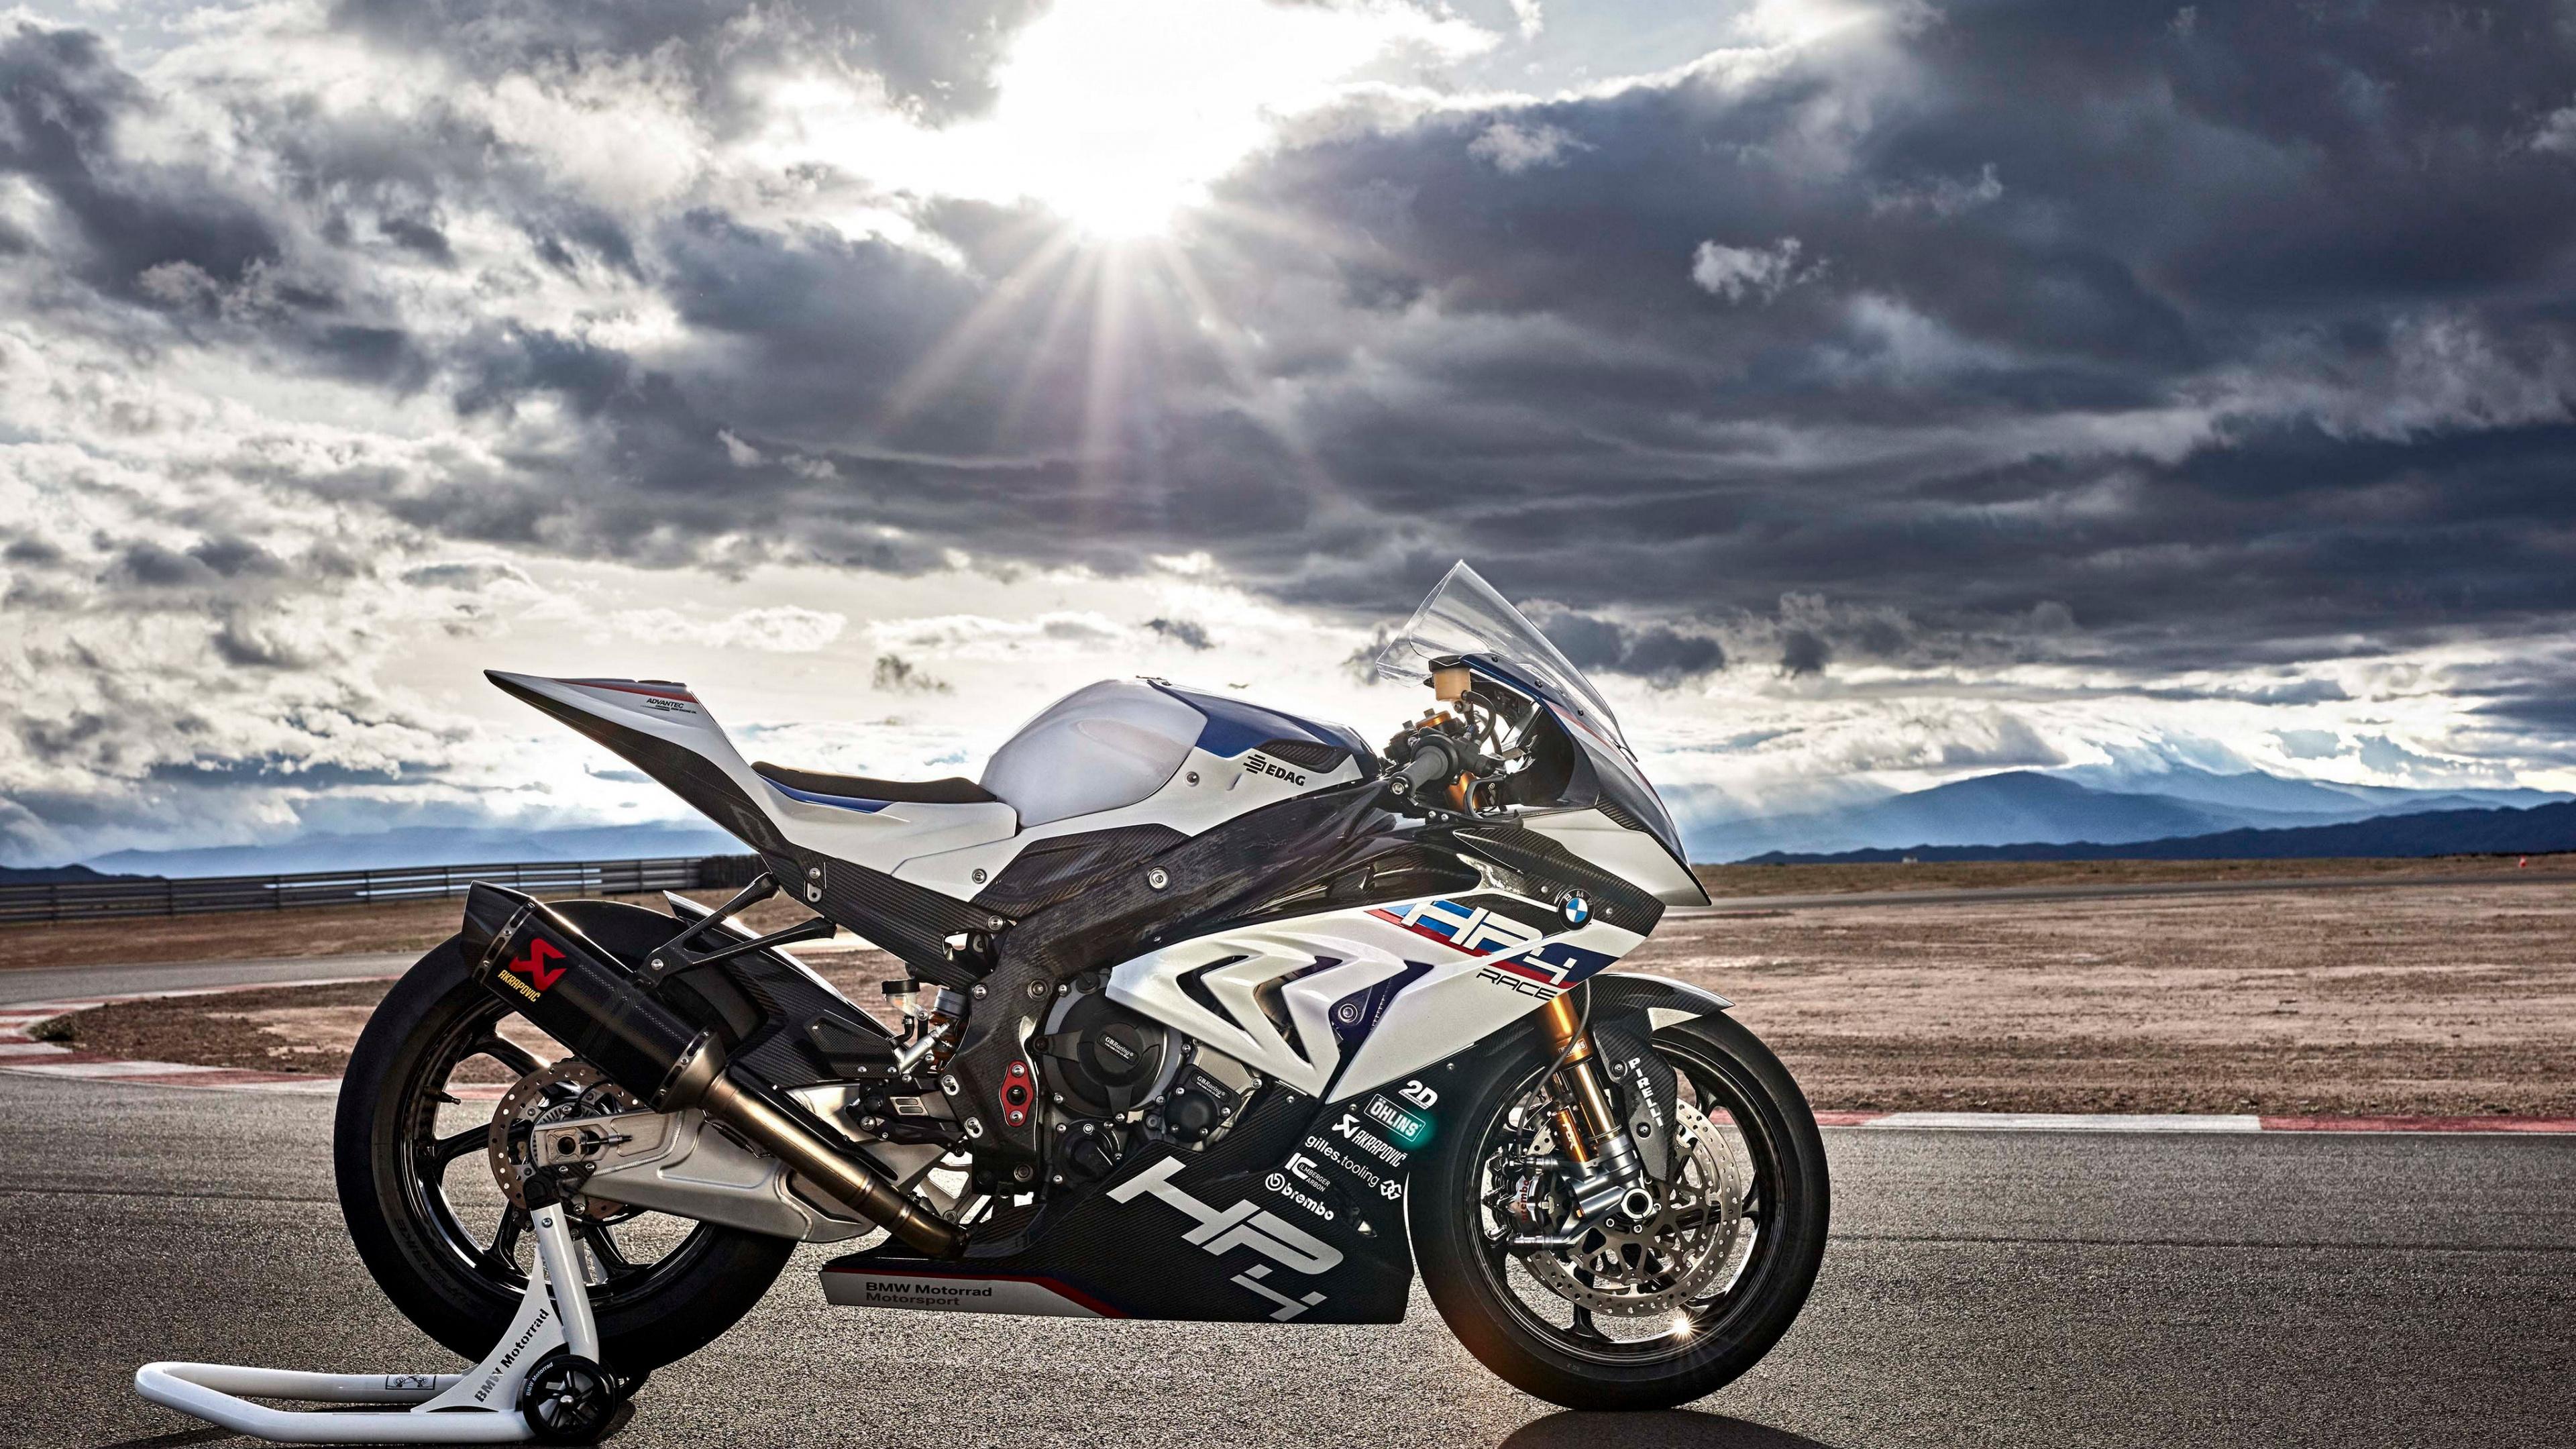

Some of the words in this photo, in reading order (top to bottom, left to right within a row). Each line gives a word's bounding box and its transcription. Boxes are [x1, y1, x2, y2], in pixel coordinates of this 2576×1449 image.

[647, 698, 684, 708] ADVANTEC
[1265, 764, 1306, 786] EDAG
[1564, 890, 1593, 906] BMW
[1476, 968, 1558, 1001] RACE
[1398, 1079, 1438, 1108] 2D
[1628, 1057, 1664, 1128] PIRELLI
[1370, 1097, 1419, 1137] ÖHLINS
[1299, 1163, 1331, 1187] ILMBERGER
[1281, 1182, 1334, 1221] brembo
[866, 1282, 910, 1293] BMW
[915, 1284, 992, 1296] Motorrad
[866, 1292, 960, 1305] Motorsport
[474, 1367, 503, 1403] BMW
[500, 1308, 549, 1368] Motorrad
[526, 1381, 534, 1396] BMW
[531, 1362, 553, 1381] Motorrad
